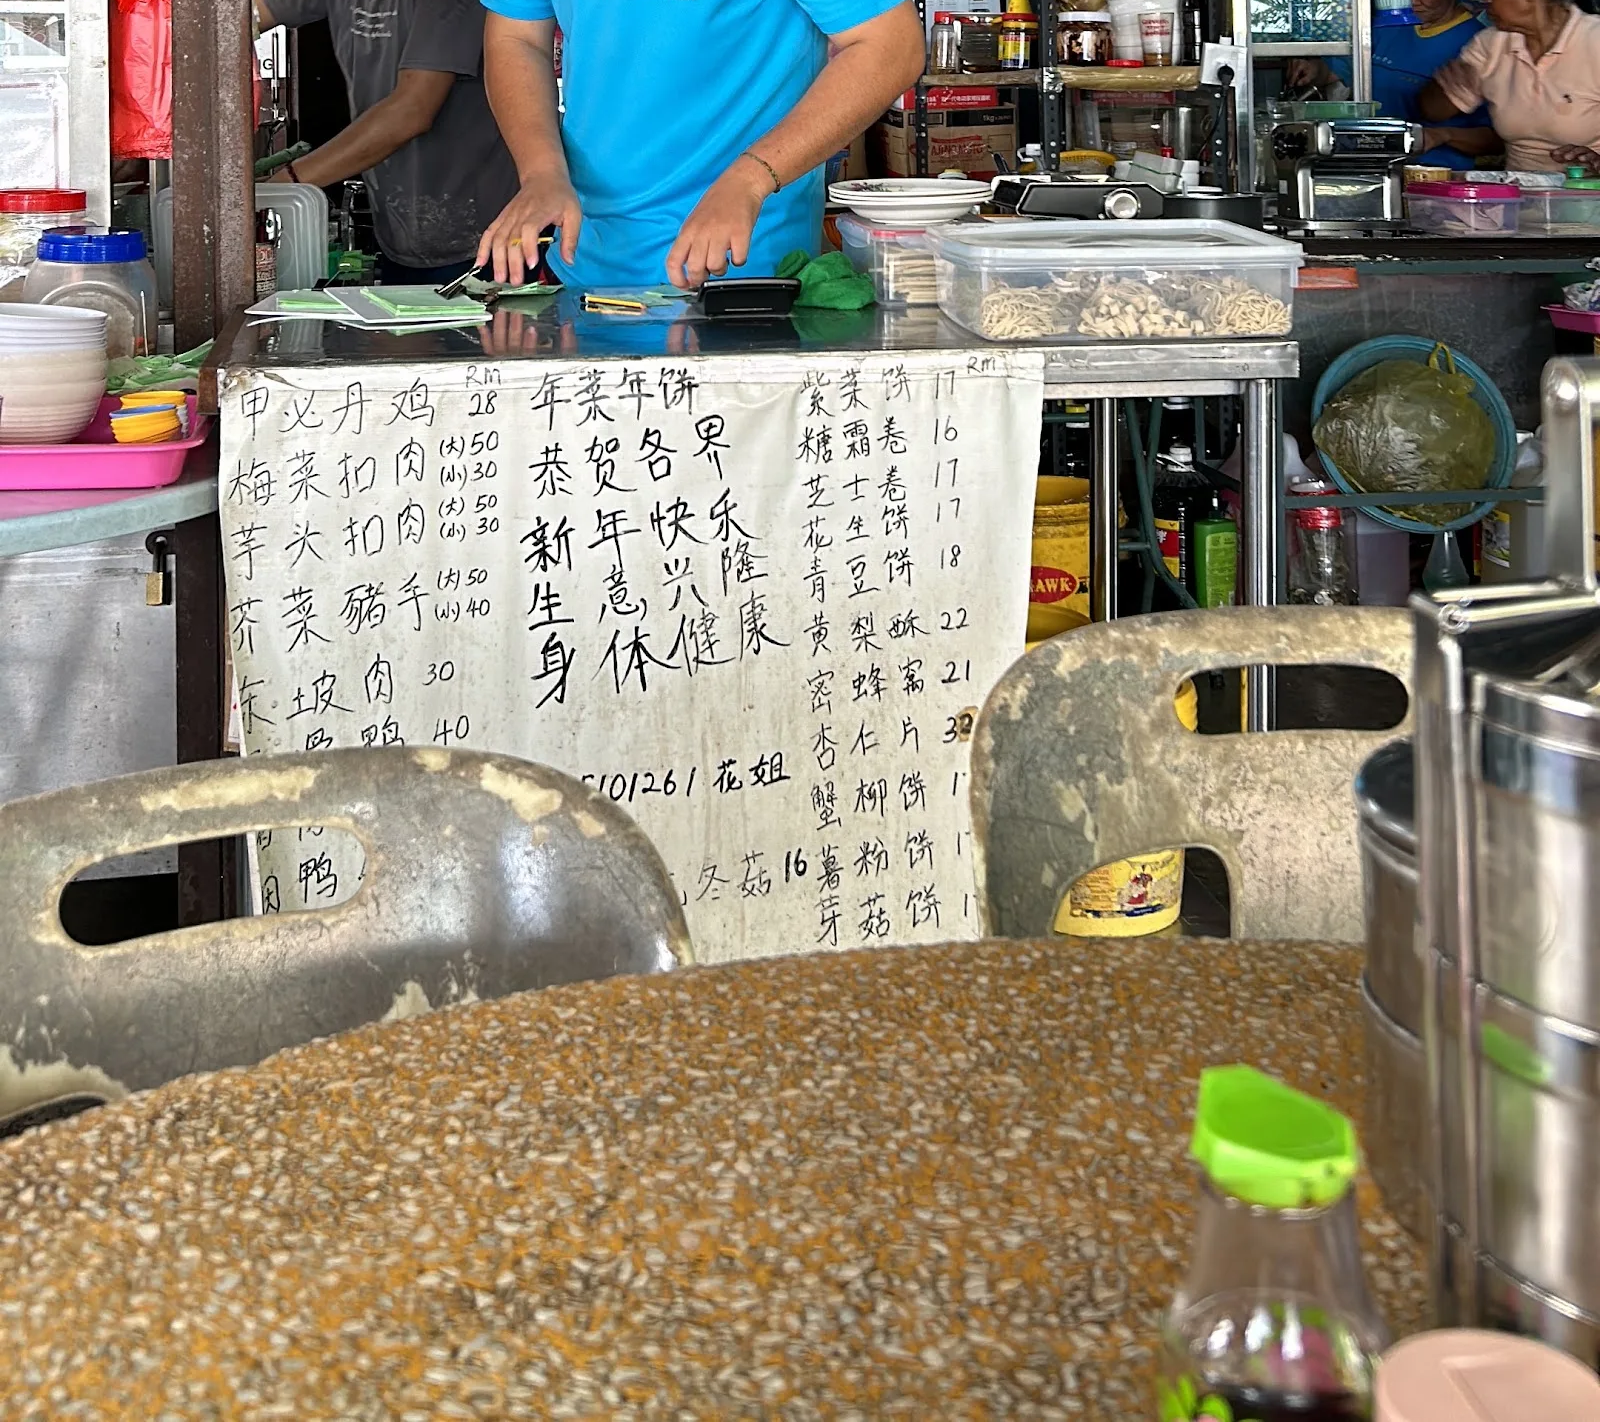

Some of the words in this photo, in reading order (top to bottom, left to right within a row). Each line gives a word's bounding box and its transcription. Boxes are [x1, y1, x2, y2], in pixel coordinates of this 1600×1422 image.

[241, 377, 435, 441] 甲必丹鸡
[468, 390, 497, 417] 28
[531, 367, 700, 431] 年菜年饼
[800, 363, 911, 418] 紫菜饼
[935, 370, 956, 400] 17
[529, 414, 731, 499] 恭贺各界
[795, 416, 907, 464] 糖霜卷
[934, 418, 958, 445] 16
[227, 436, 425, 506] 梅菜扣肉
[470, 430, 499, 453] 50
[473, 460, 498, 479] 30
[801, 464, 907, 510] 芝士卷
[934, 458, 959, 488] 17
[229, 498, 426, 581] 芋头扣肉
[473, 494, 498, 513] 50
[476, 517, 500, 535] 30
[519, 487, 763, 574] 新年快乐
[801, 503, 911, 554] 花生饼
[936, 497, 961, 523] 17
[465, 568, 489, 587] 50
[527, 537, 769, 632] 生意兴隆
[803, 547, 915, 604] 青豆饼
[940, 544, 962, 570] 18
[1030, 577, 1072, 593] AWK
[465, 598, 491, 618] 40
[803, 608, 930, 658] 黄梨酥
[940, 607, 970, 631] 22
[422, 661, 456, 686] 30
[530, 590, 791, 709] 身体健康
[941, 659, 970, 684] 21
[433, 715, 471, 746] 40
[810, 715, 920, 771] 杏仁片
[712, 751, 791, 794] 花姐
[810, 770, 927, 831] 蟹柳饼
[785, 847, 808, 883] 16
[815, 829, 934, 893] 薯粉饼
[814, 882, 942, 947] 芽菇饼
